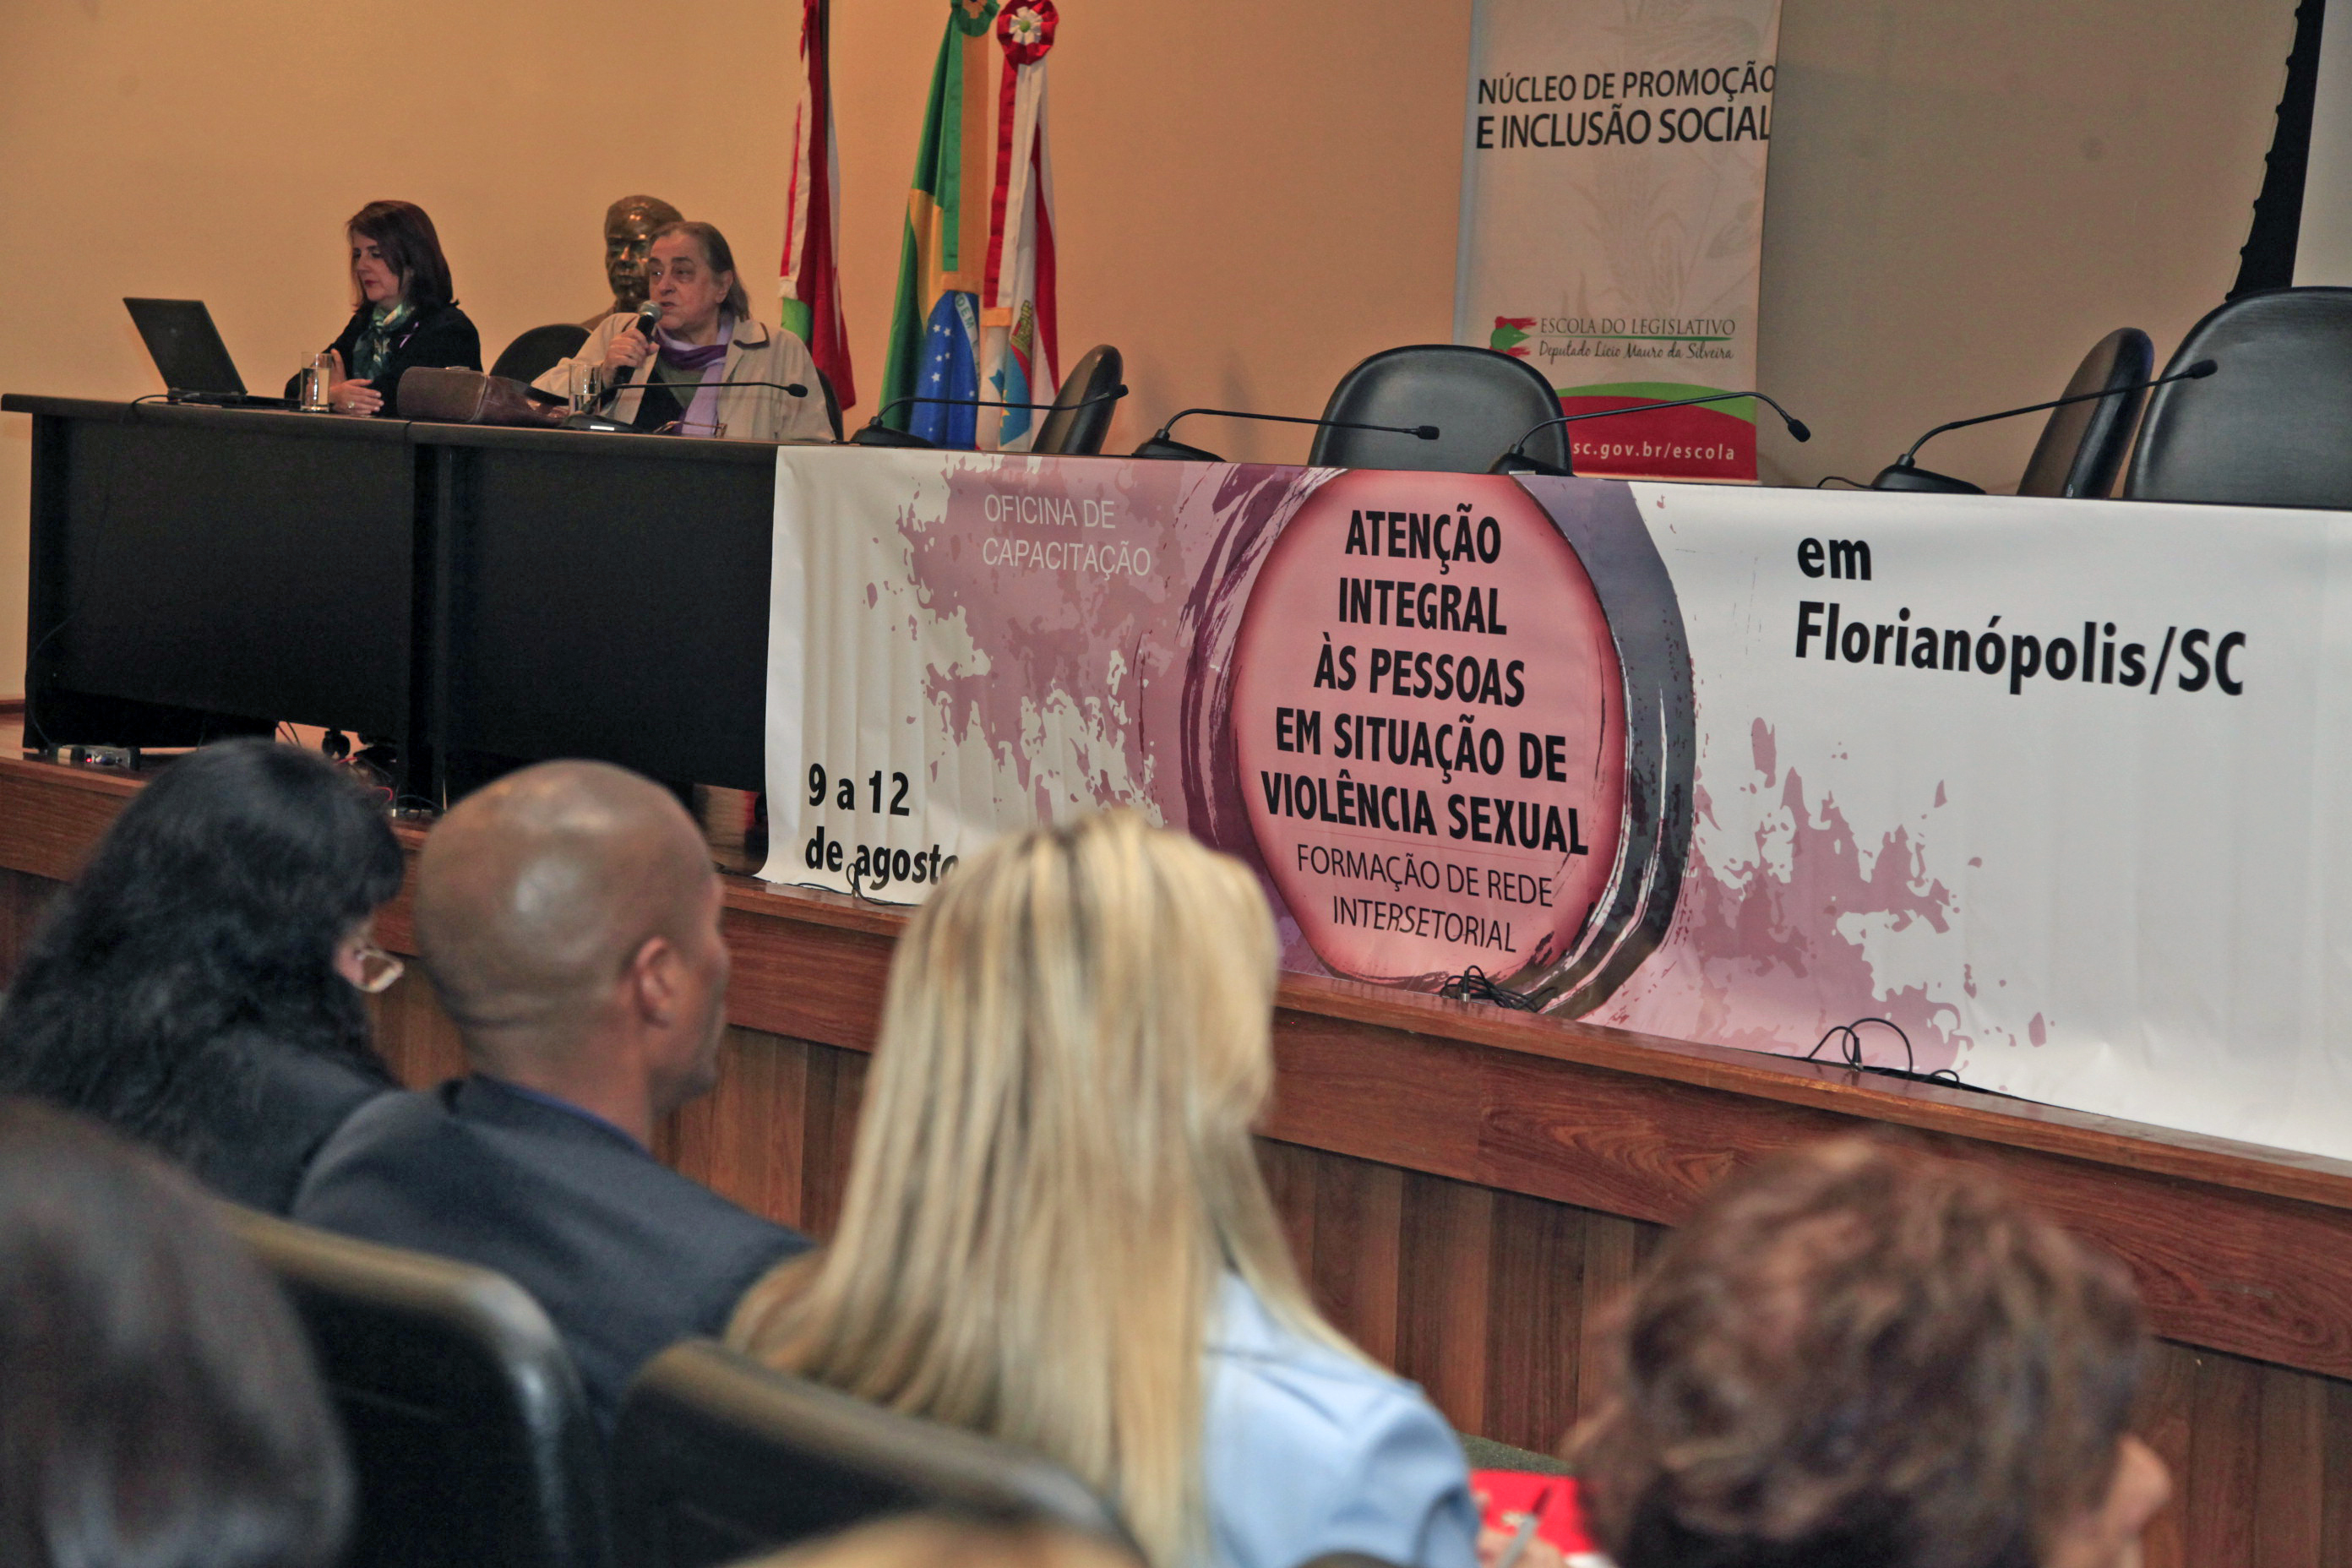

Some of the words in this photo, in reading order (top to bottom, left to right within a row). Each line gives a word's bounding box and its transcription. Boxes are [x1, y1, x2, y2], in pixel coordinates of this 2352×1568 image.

[1478, 73, 1576, 104] NÚCLEO
[1583, 73, 1615, 100] DE
[1623, 60, 1776, 102] PROMOÇÃO
[1477, 116, 1494, 149] E
[1501, 103, 1652, 149] INCLUSÃO
[1658, 105, 1771, 144] SOCIAL
[1540, 318, 1596, 335] ESCOLA
[1602, 318, 1626, 335] DO
[1631, 318, 1736, 335] LEGISLATIVO
[1539, 340, 1592, 365] Deputado
[1623, 342, 1664, 359] Mauro
[1667, 340, 1683, 359] da
[1685, 340, 1734, 359] Silveira
[1573, 441, 1734, 460] sc.gov.br/escola
[984, 494, 1077, 526] OFICINA
[1084, 499, 1116, 529] DE
[982, 537, 1152, 580] CAPACITAÇÃO
[1345, 504, 1502, 574] ATENÇÃO
[1797, 536, 1873, 581] em
[1338, 577, 1507, 635] INTEGRAL
[1314, 632, 1357, 691] ÀS
[1369, 647, 1526, 707] PESSOAS
[1795, 600, 2247, 696] Florianópolis/SC
[1276, 706, 1321, 755] EM
[1333, 714, 1504, 785] SITUAÇÃO
[1520, 732, 1567, 783] DE
[808, 763, 826, 807] 9
[836, 778, 855, 811] a
[868, 770, 910, 817] 12
[1260, 768, 1438, 836] VIOLÊNCIA
[1448, 792, 1589, 856] SEXUAL
[805, 825, 843, 873] de
[1297, 843, 1440, 892] FORMAÇÃO
[1446, 864, 1479, 897] DE
[1487, 871, 1554, 907] REDE
[1333, 896, 1517, 954] INTERSETORIAL
